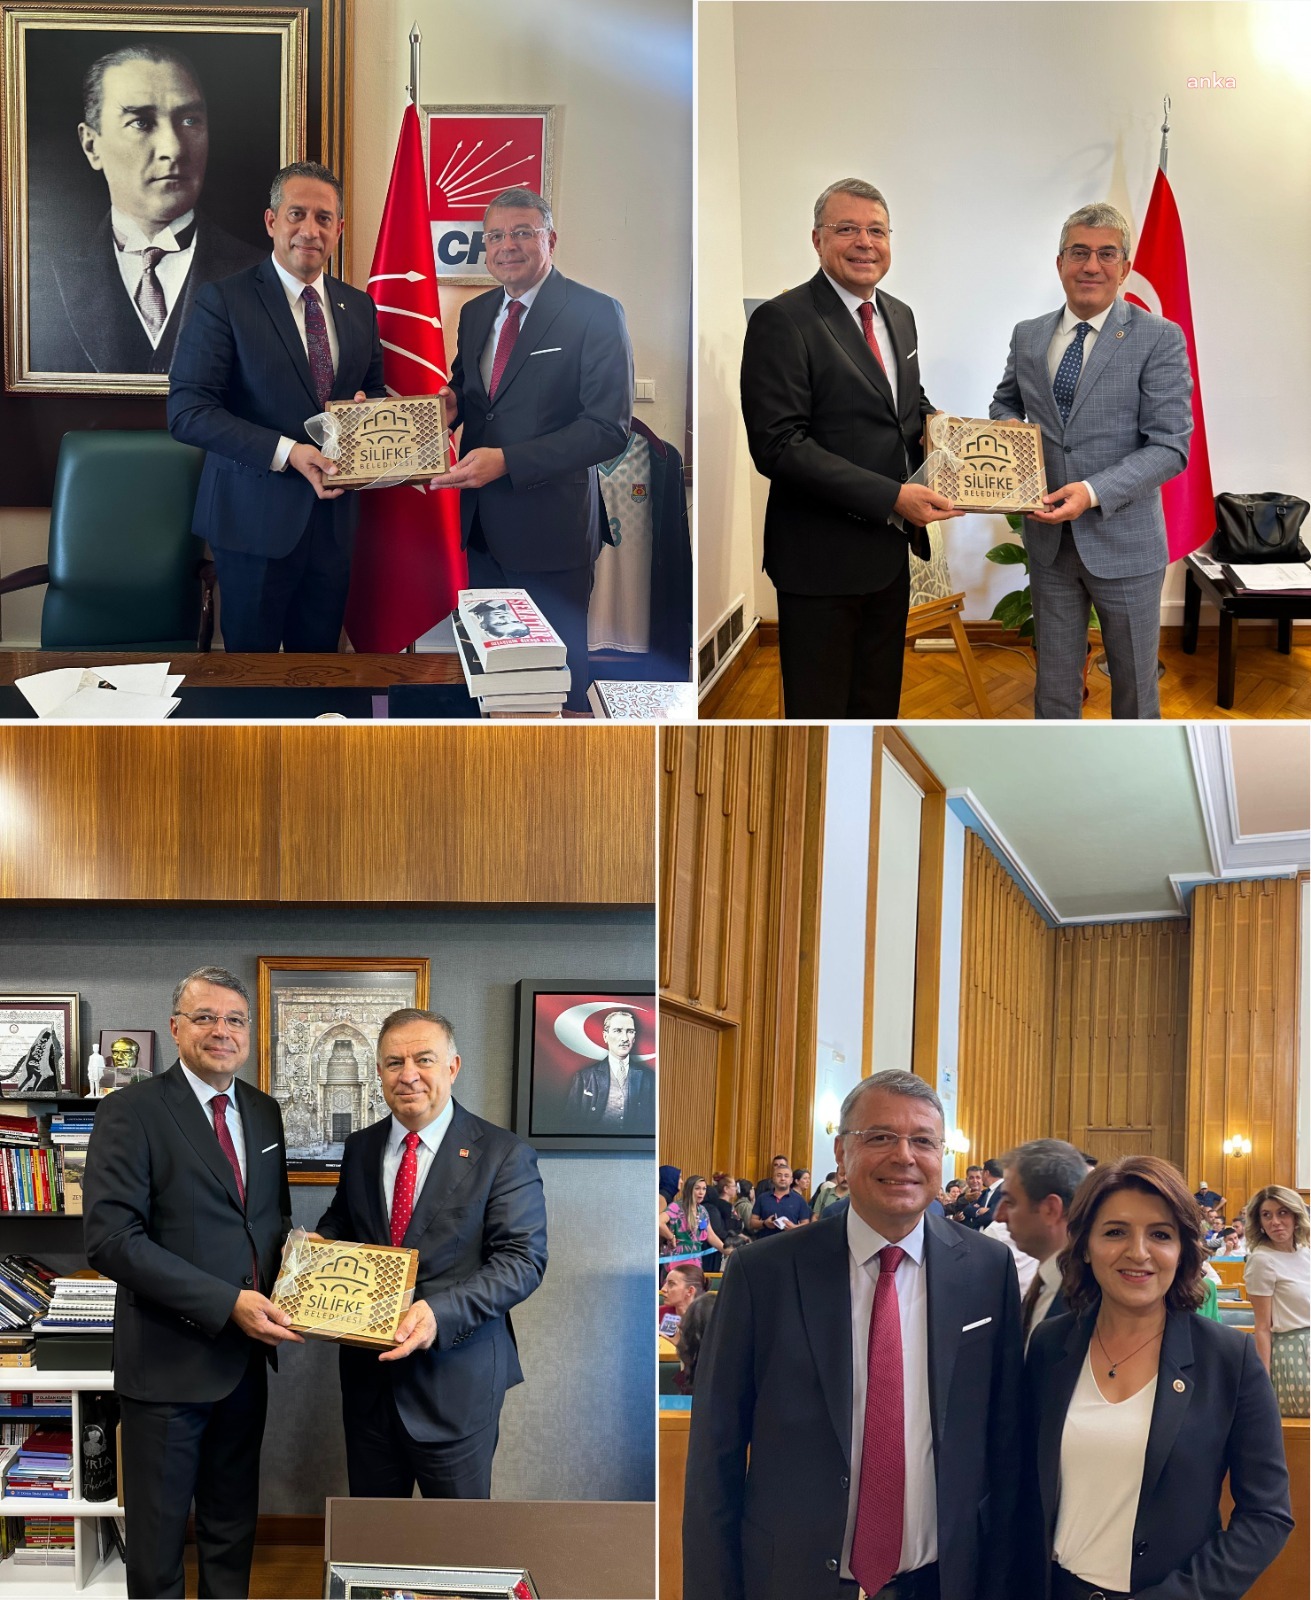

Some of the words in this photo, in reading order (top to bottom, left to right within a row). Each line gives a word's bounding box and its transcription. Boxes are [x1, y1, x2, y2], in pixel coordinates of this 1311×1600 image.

[360, 446, 412, 461] SİLİFKE
[964, 473, 1014, 491] SİLİFKE
[307, 1293, 365, 1315] SİLİFKE
